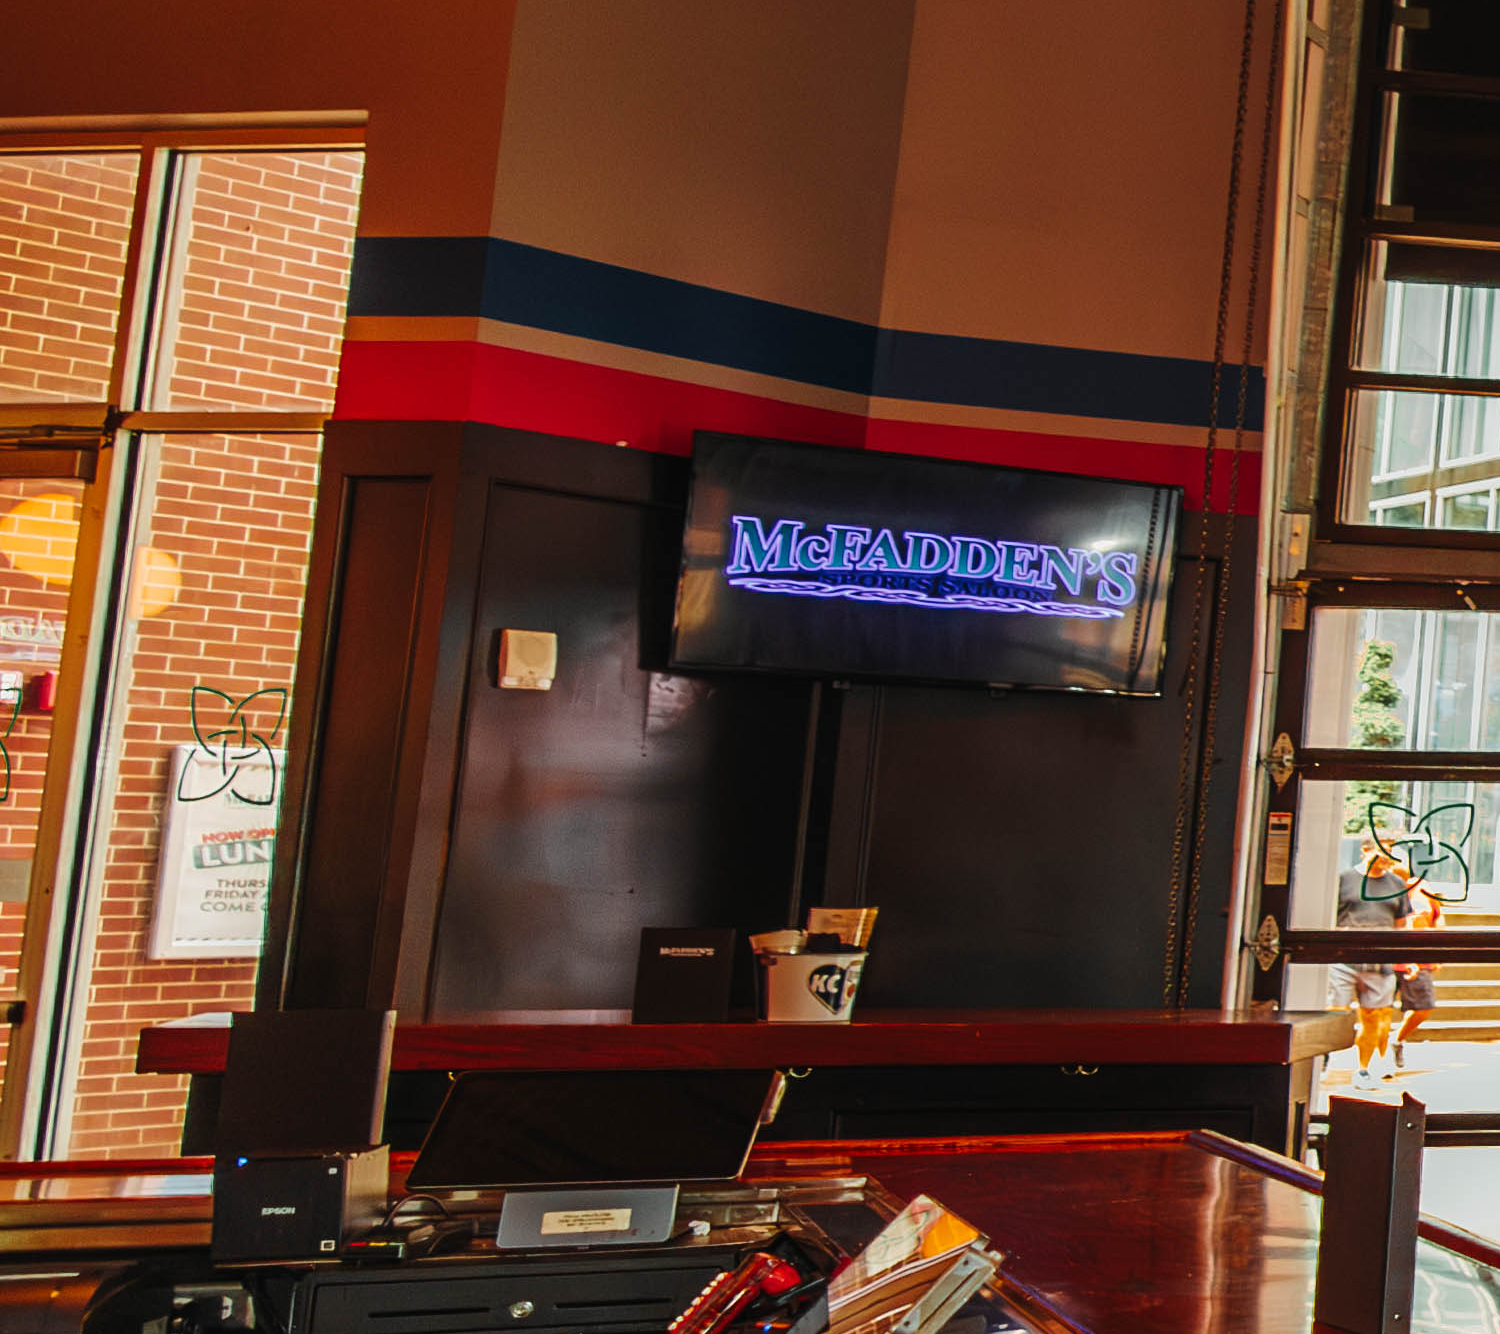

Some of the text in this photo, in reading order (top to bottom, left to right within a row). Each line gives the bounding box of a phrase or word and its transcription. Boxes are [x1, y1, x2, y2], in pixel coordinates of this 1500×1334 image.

[727, 514, 1139, 607] McFADDEN'S
[821, 572, 1054, 604] SPORTS SALOON
[205, 889, 259, 899] FRIDAY
[200, 901, 256, 912] COME
[810, 974, 841, 994] KC
[261, 1207, 296, 1216] EPSON
